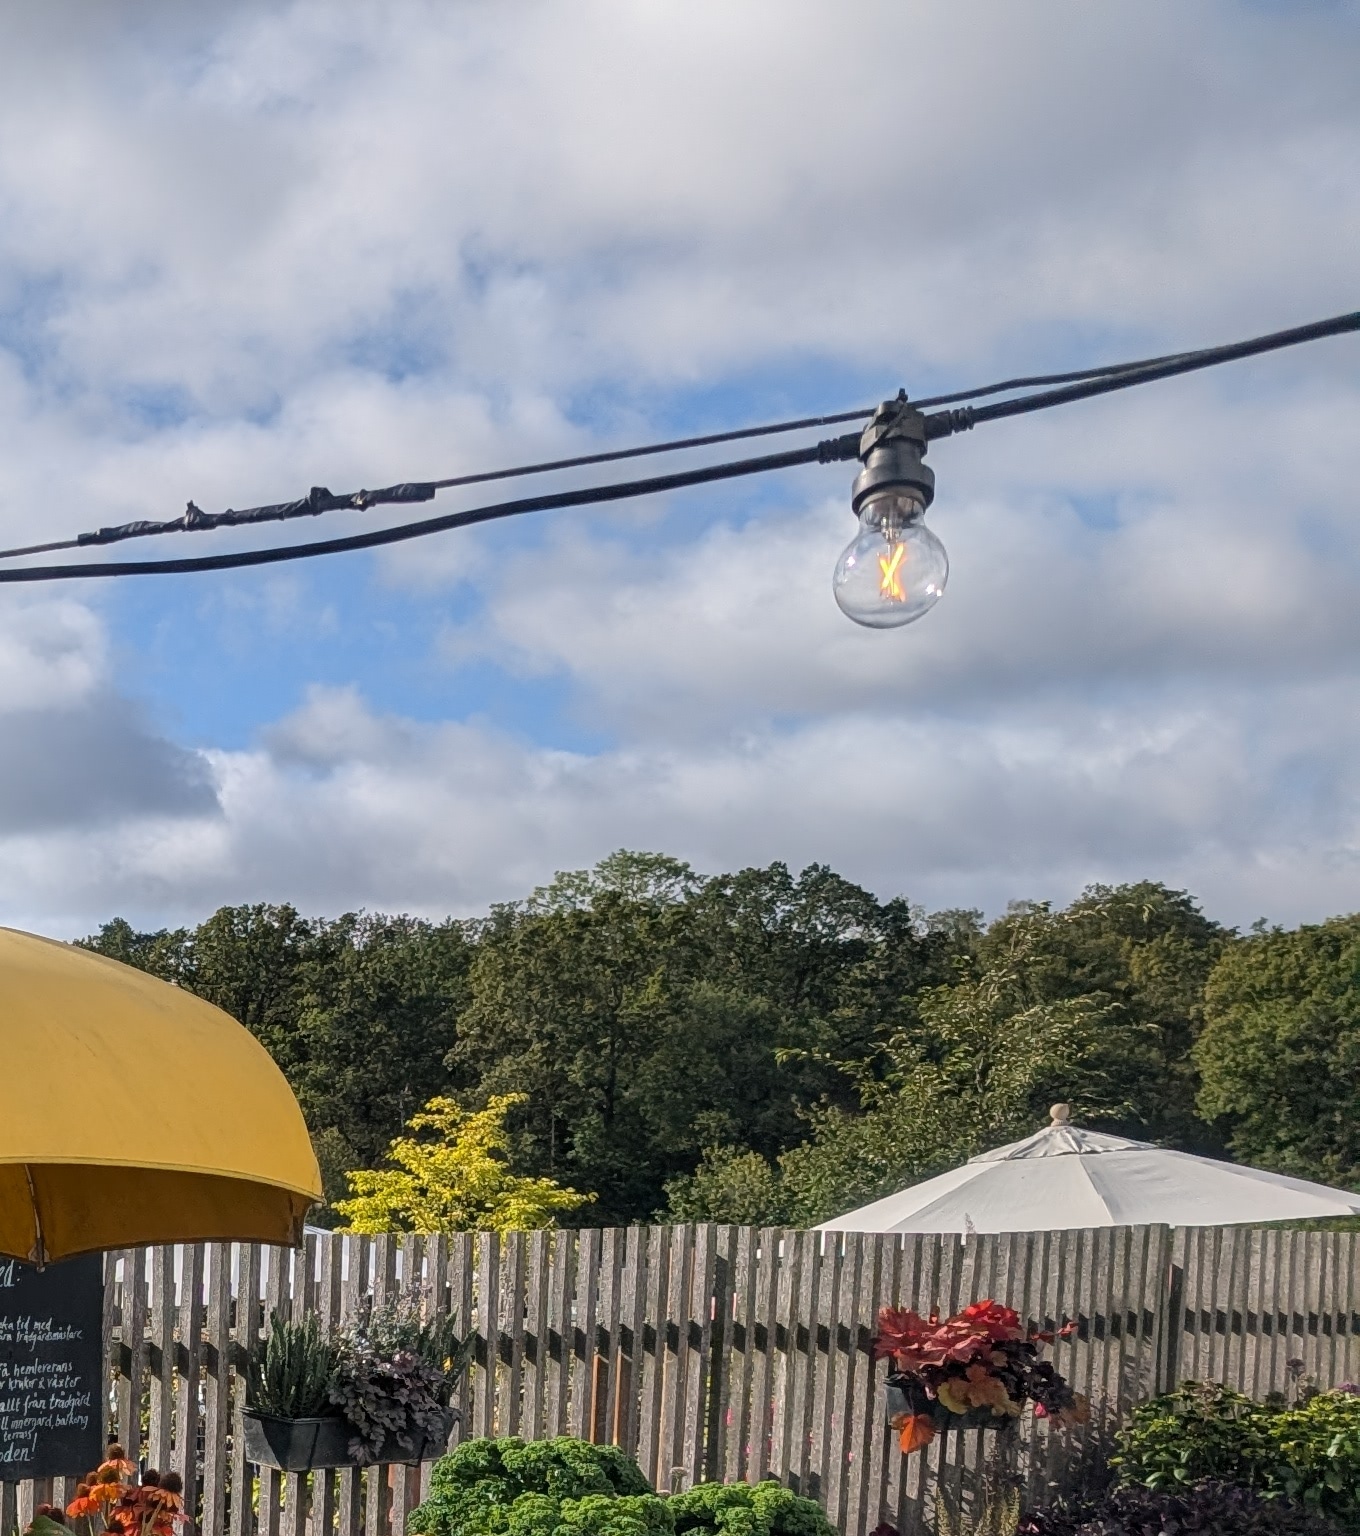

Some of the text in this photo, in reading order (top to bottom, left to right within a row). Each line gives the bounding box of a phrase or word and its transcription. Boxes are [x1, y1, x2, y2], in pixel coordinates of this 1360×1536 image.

[17, 1316, 31, 1331] tid
[33, 1317, 53, 1331] med
[23, 1392, 47, 1416] från
